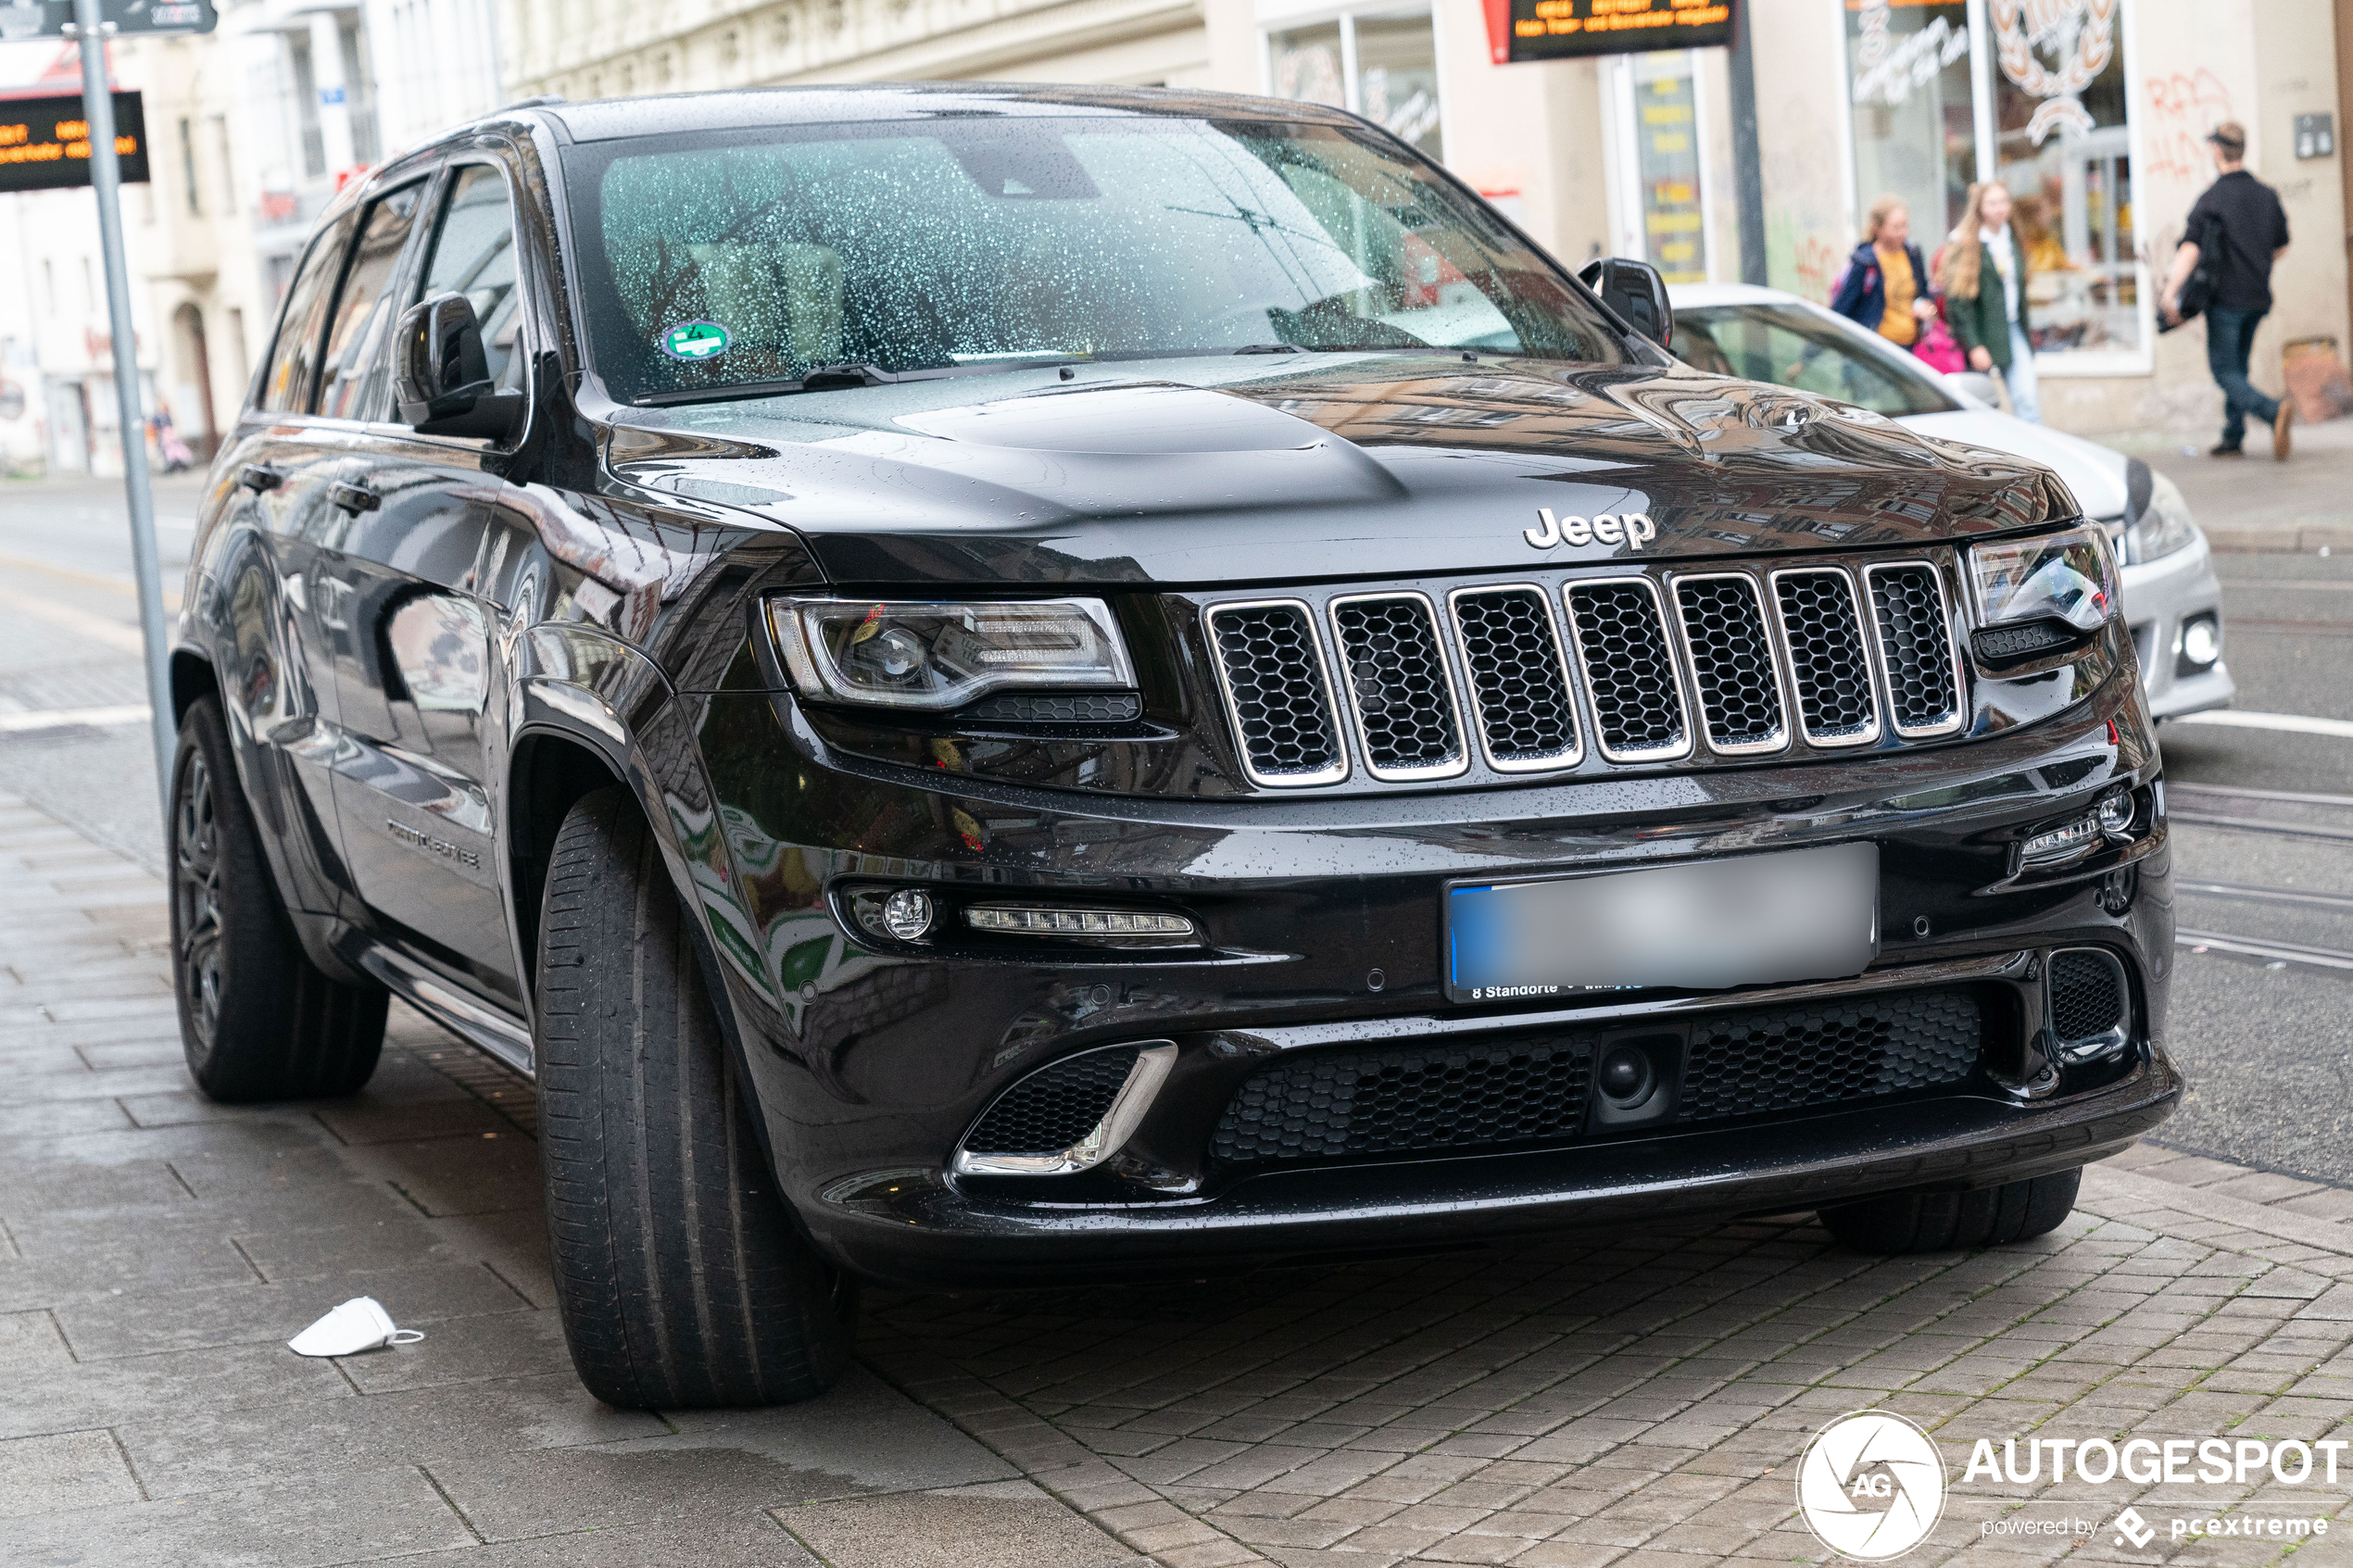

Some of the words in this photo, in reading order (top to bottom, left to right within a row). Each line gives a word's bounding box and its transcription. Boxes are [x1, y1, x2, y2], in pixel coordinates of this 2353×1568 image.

[688, 326, 704, 339] 4
[1523, 508, 1655, 551] Jeep
[1473, 987, 1481, 998] 8
